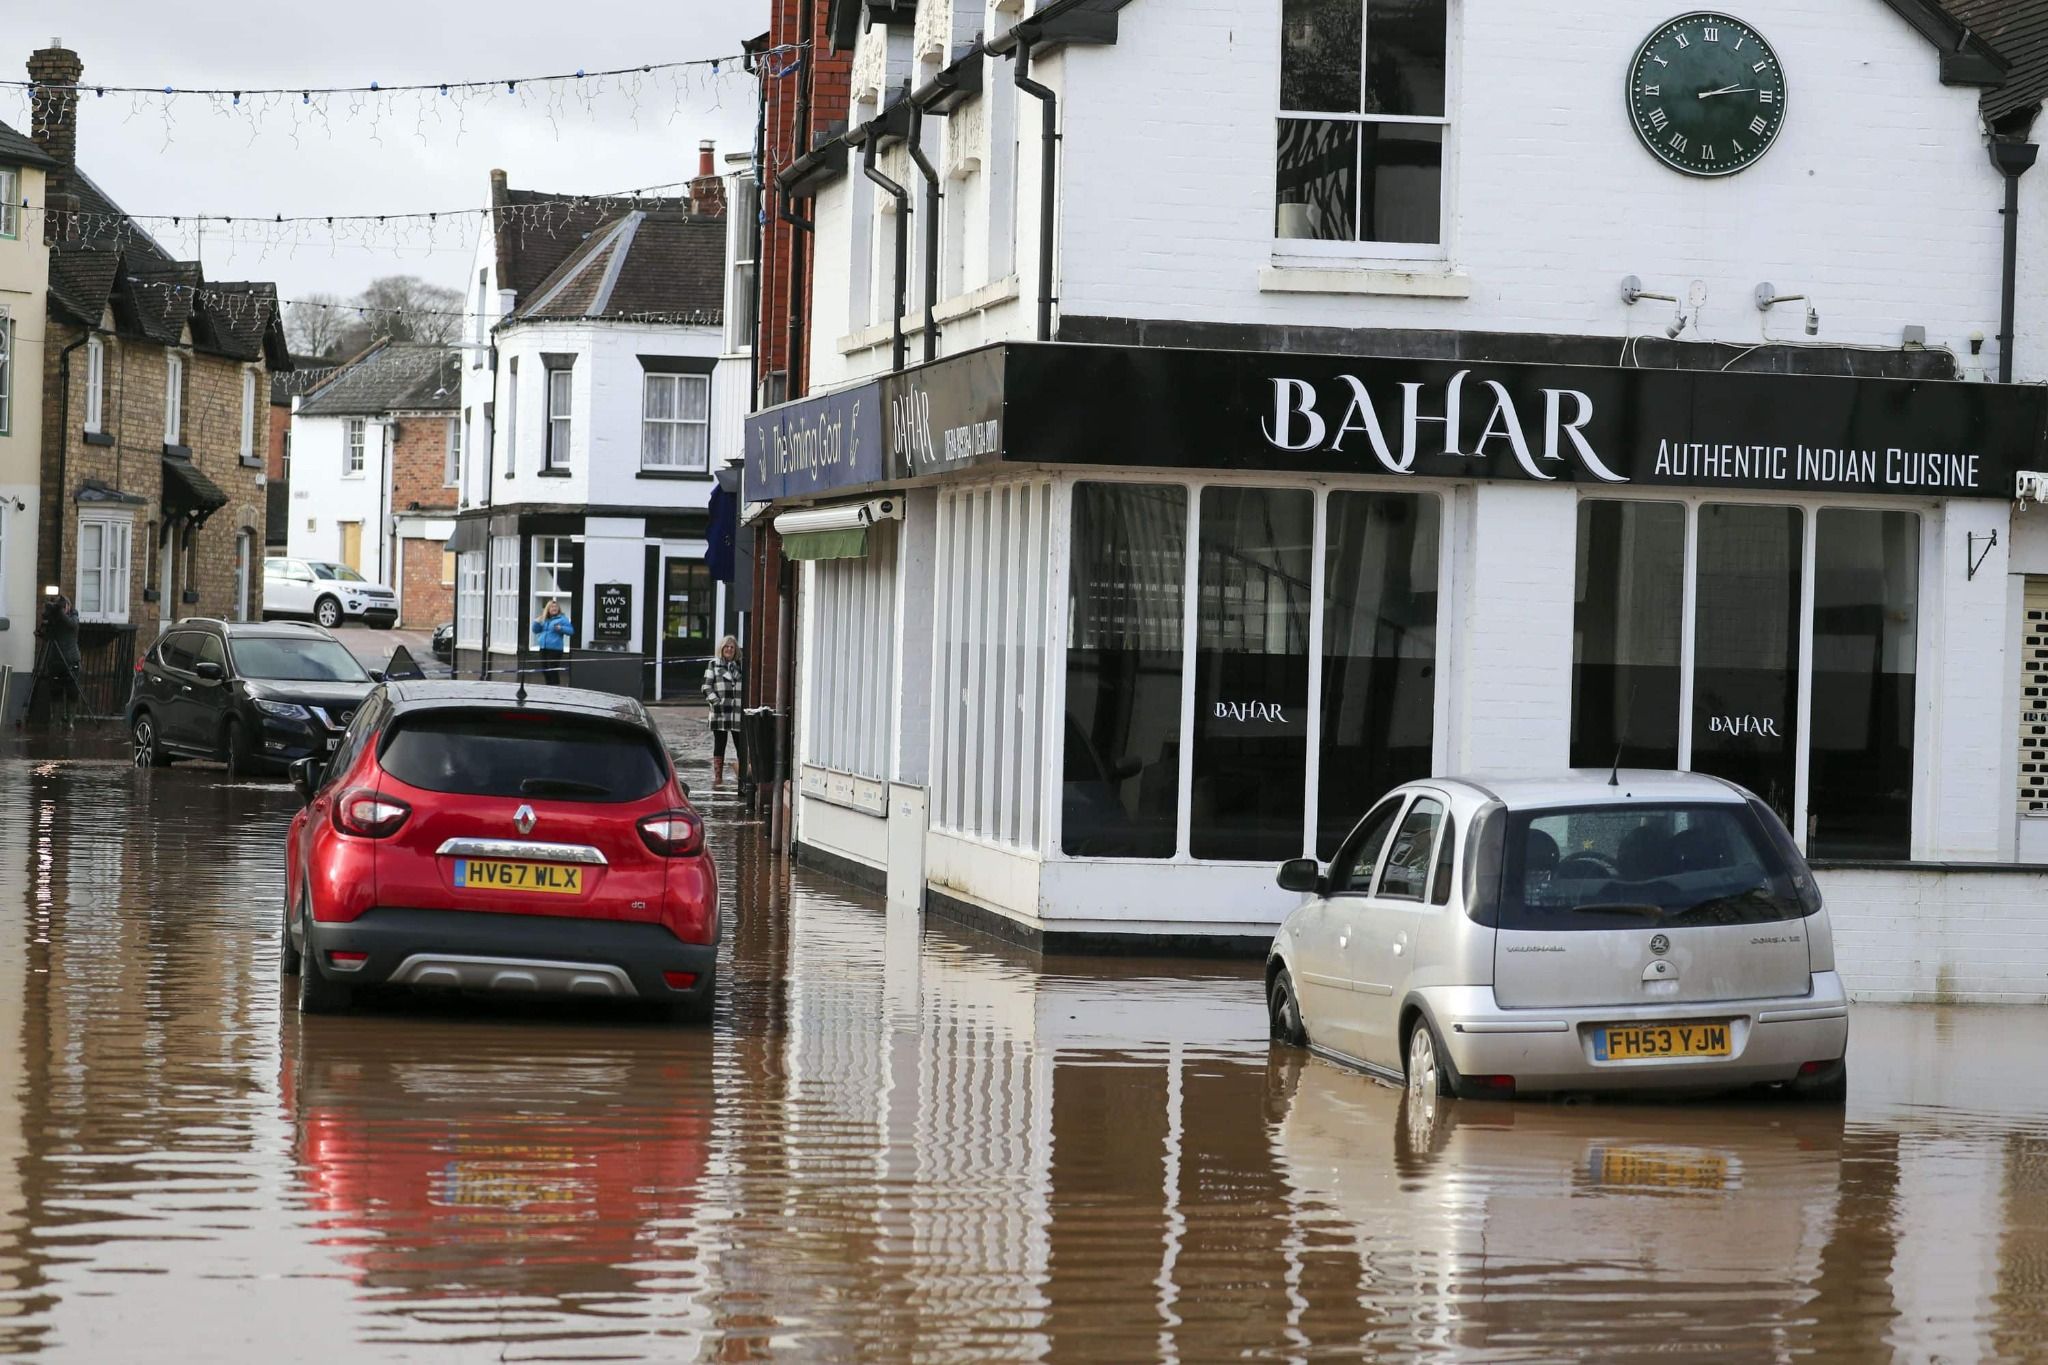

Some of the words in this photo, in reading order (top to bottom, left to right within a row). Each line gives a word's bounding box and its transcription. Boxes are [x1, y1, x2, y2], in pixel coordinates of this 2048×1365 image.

[1675, 34, 1689, 49] XI
[1704, 28, 1719, 41] XII
[1734, 38, 1744, 50] I
[1653, 55, 1668, 67] X
[1753, 61, 1767, 73] II
[1645, 84, 1660, 96] IX
[1760, 90, 1772, 103] III
[1649, 108, 1669, 132] VIII
[1749, 116, 1767, 135] IIII
[1669, 132, 1688, 153] VII
[1701, 144, 1715, 159] VI
[1732, 139, 1743, 154] V
[893, 384, 936, 467] BAHAR
[1261, 369, 1631, 483] BAHAR
[773, 425, 788, 475] The
[788, 420, 817, 481] Smiling
[819, 409, 842, 467] Goat
[1654, 438, 1787, 480] AUTHENTIC
[1797, 444, 1876, 483] INDIAN
[1885, 448, 1980, 488] CUISINE
[601, 596, 626, 605] TAV'S
[1213, 700, 1289, 723] BAHAR
[1708, 714, 1781, 737] BAHAR
[469, 862, 527, 885] HV67
[535, 866, 577, 888] WLX
[1609, 1030, 1672, 1055] FH53
[1679, 1027, 1726, 1052] YJM
